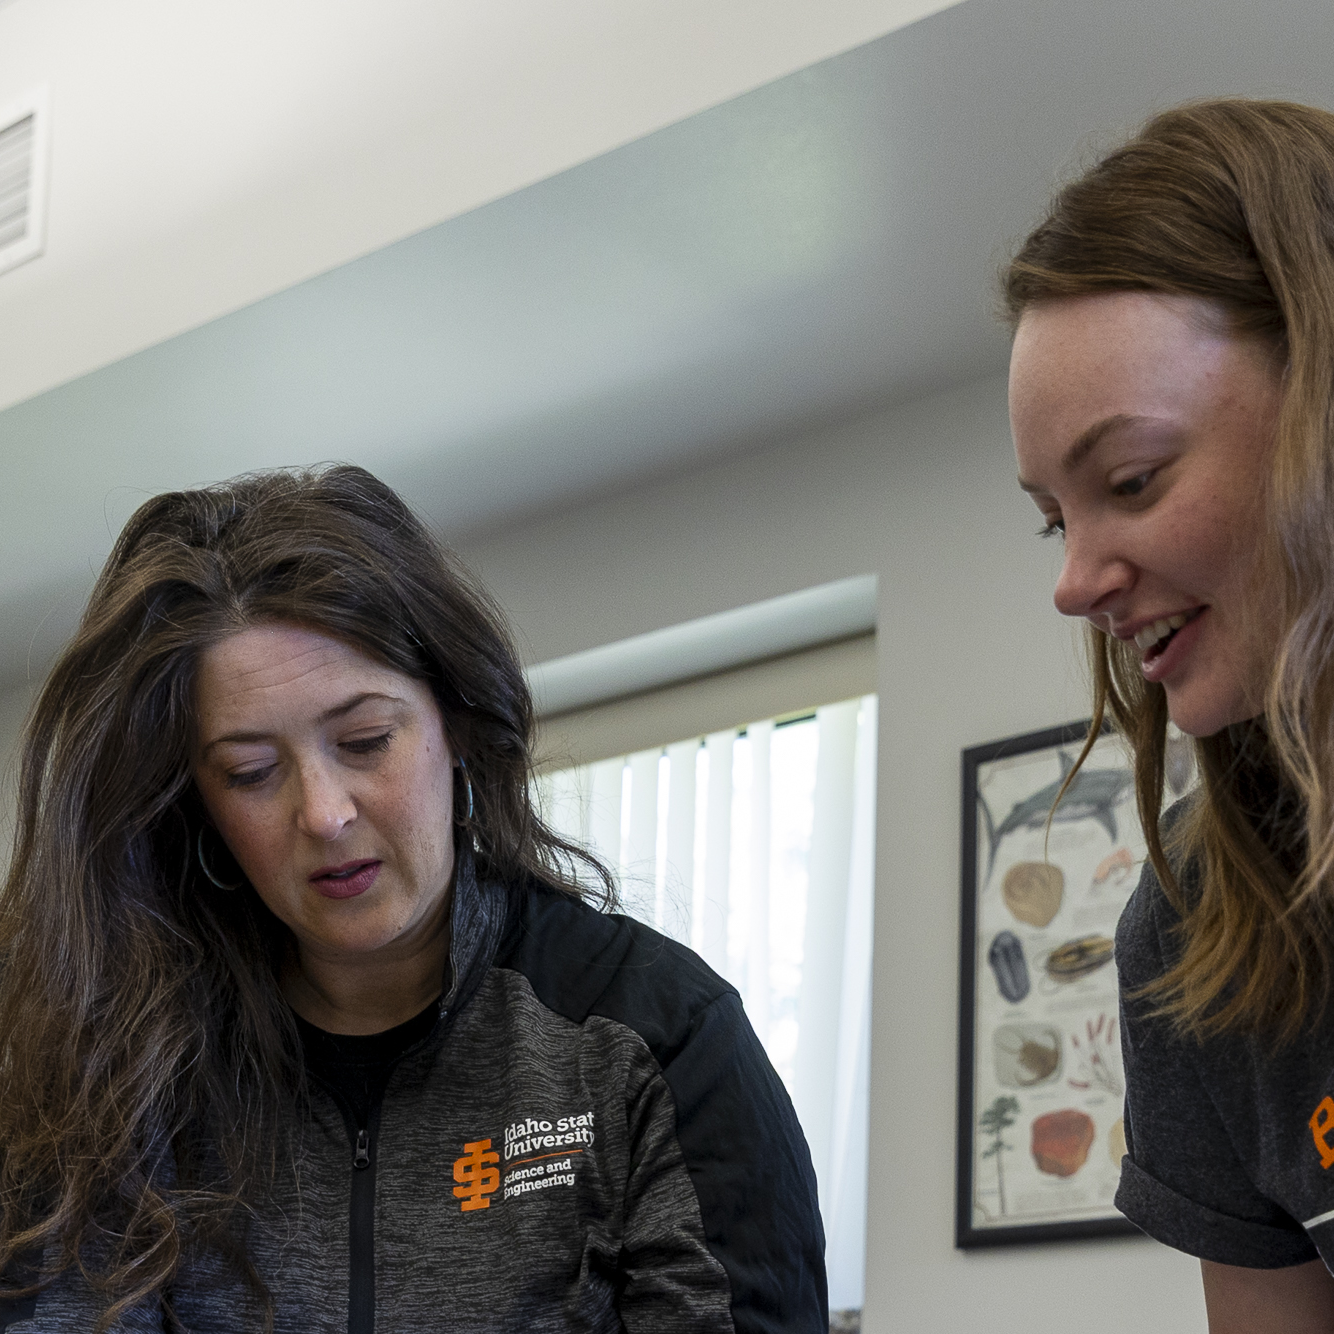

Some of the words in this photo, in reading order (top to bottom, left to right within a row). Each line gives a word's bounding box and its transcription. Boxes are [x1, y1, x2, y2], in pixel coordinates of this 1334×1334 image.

[504, 1118, 552, 1145] Idaho
[557, 1111, 595, 1132] Stat
[504, 1127, 595, 1161] University
[504, 1164, 545, 1187] Science
[546, 1158, 572, 1174] and
[504, 1173, 576, 1201] Engineering
